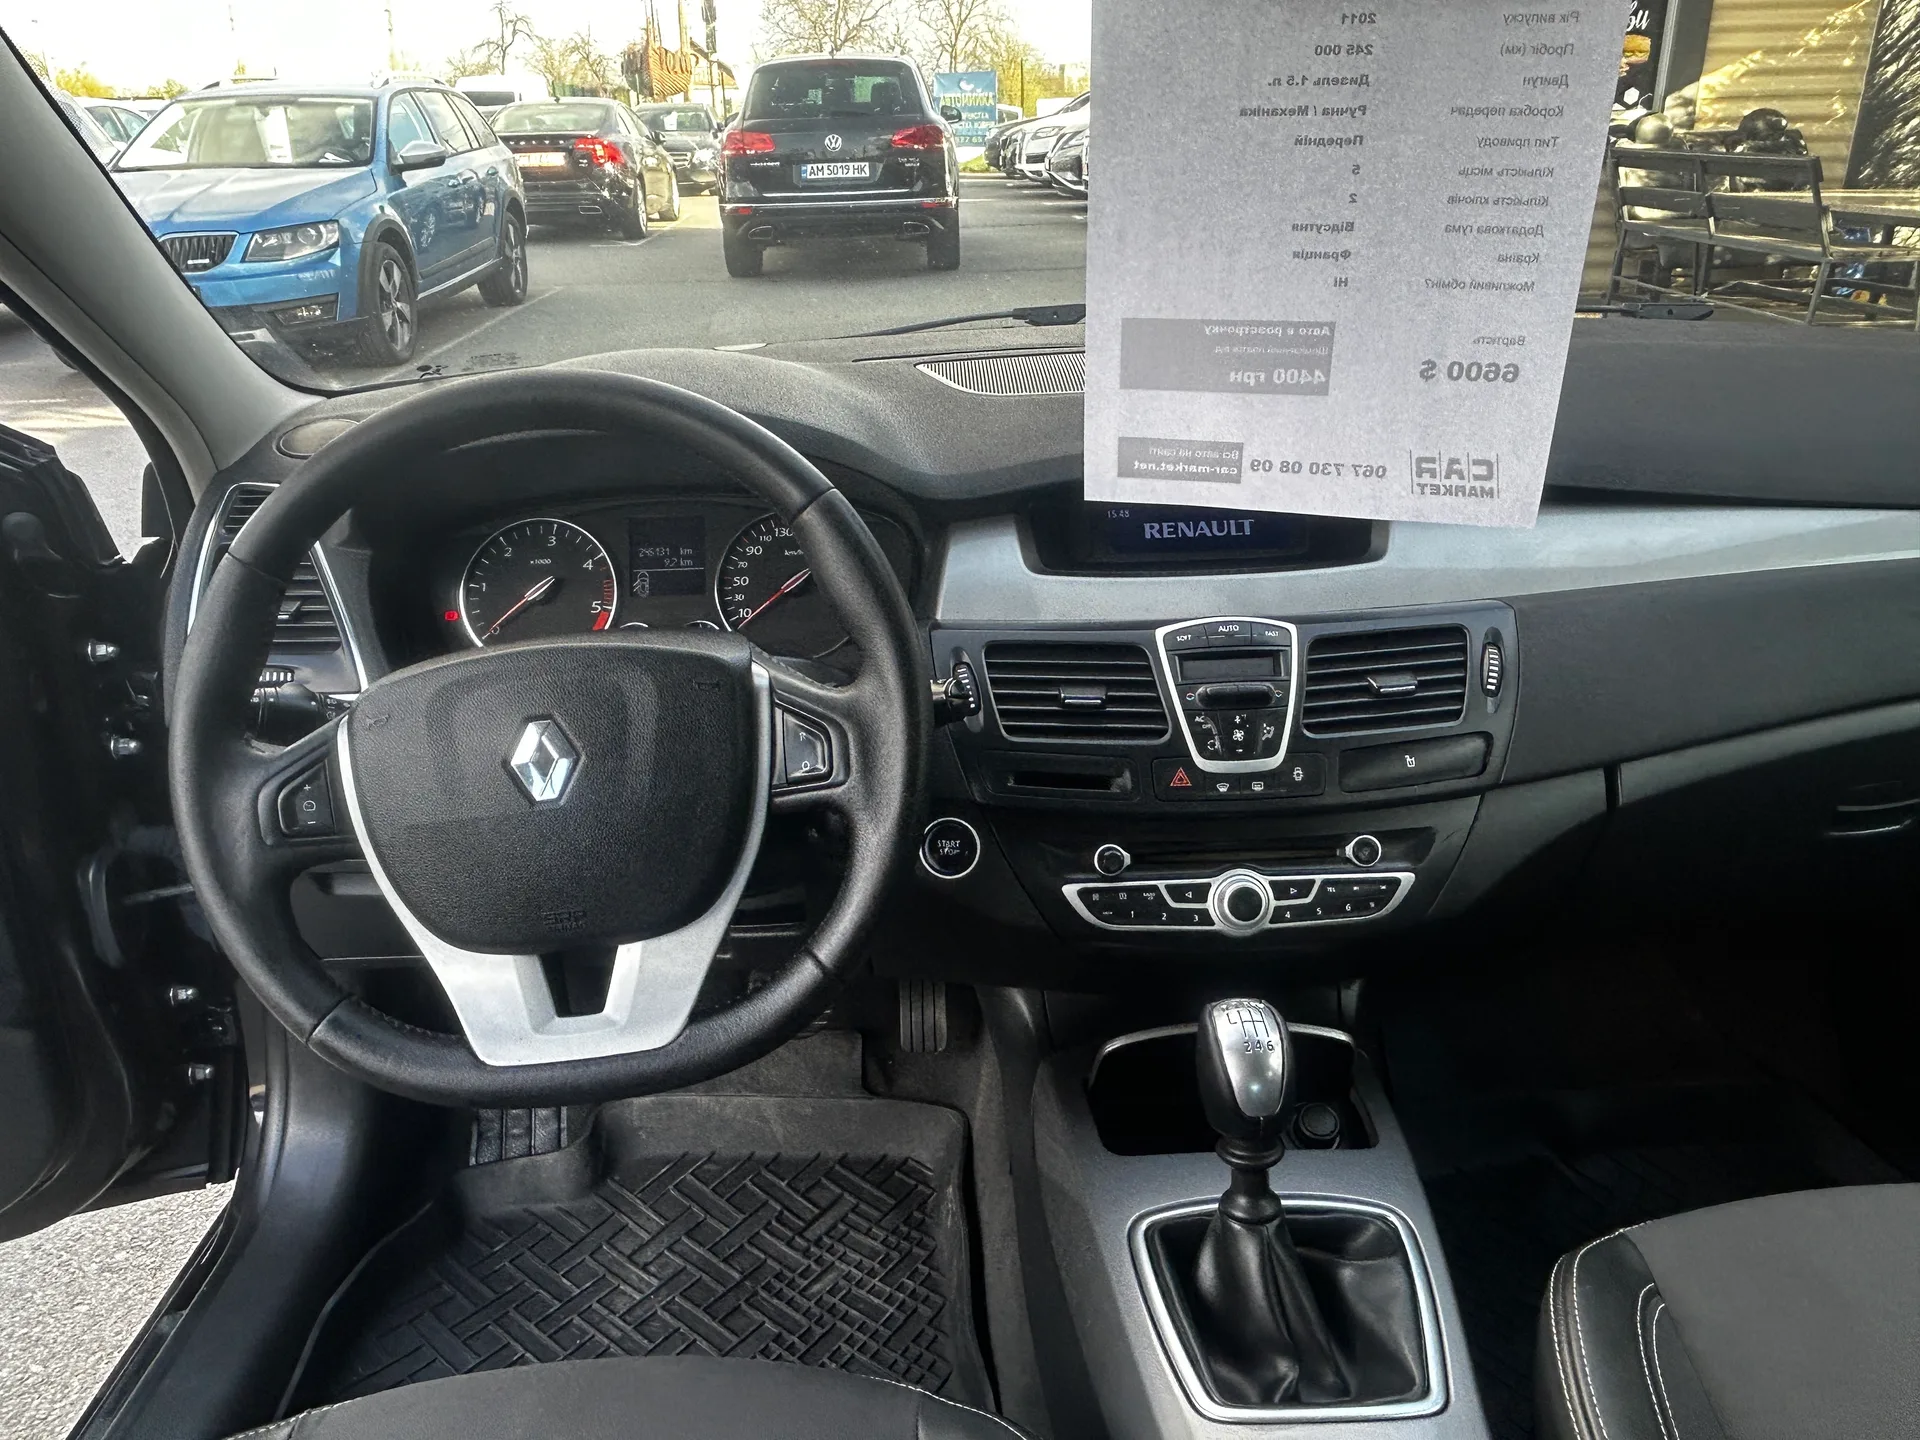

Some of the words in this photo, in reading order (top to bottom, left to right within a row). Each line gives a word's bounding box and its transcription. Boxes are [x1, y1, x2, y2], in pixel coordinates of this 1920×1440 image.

[808, 164, 825, 176] AM
[826, 163, 850, 176] 5019
[852, 162, 868, 175] HK
[1144, 519, 1255, 539] RENAULT
[548, 536, 557, 546] 3
[759, 534, 773, 542] 110
[504, 547, 513, 558] 2
[746, 546, 763, 556] 90
[582, 559, 594, 571] 4
[737, 560, 748, 568] 70
[732, 576, 750, 587] 50
[590, 601, 602, 614] 5
[738, 608, 752, 618] 10
[1218, 624, 1240, 632] AUTO
[937, 840, 960, 848] START
[1316, 908, 1322, 916] 5
[1346, 904, 1352, 912] 6
[1162, 912, 1167, 921] 2
[1193, 914, 1199, 922] 3
[1284, 911, 1291, 919] 4
[1244, 1042, 1252, 1054] 2
[1255, 1040, 1262, 1052] 4
[1266, 1040, 1274, 1052] 6
